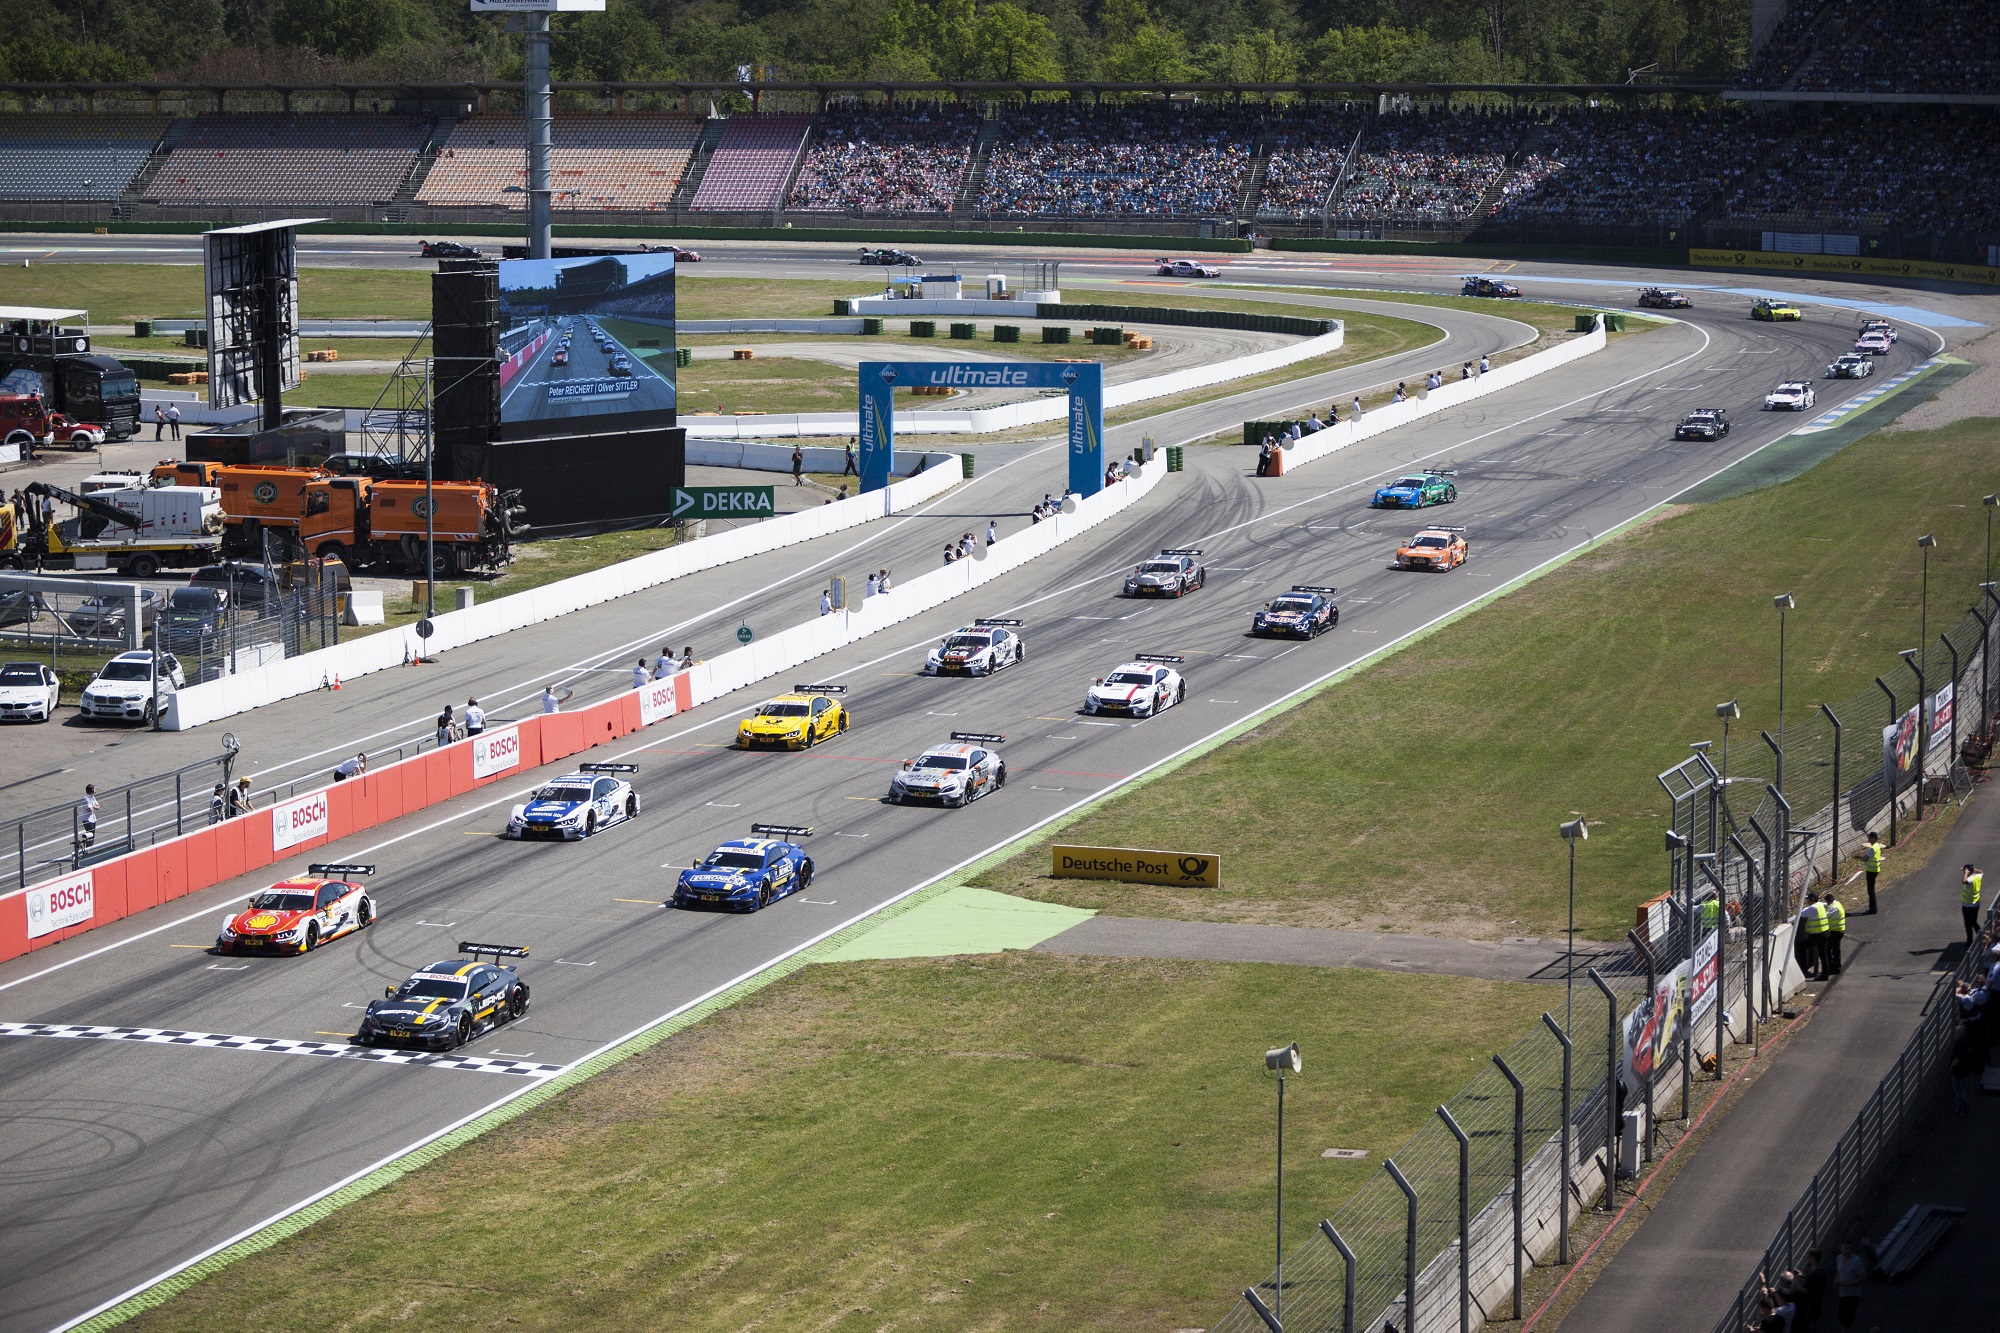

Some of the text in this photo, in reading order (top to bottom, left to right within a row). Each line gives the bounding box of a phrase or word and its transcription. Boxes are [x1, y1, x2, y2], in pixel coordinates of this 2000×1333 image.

[1694, 254, 1720, 262] Deutsche
[1755, 258, 1781, 266] Deutsche
[1812, 261, 1839, 269] Deutsche
[930, 366, 1028, 384] ultimate
[549, 387, 564, 396] Peter
[565, 384, 594, 394] REICHERT
[598, 382, 614, 392] Oliver
[615, 380, 638, 391] SITTLER
[862, 394, 874, 452] ultimate
[1070, 396, 1083, 454] ultimate
[704, 492, 771, 511] DEKRA
[653, 685, 674, 707] BOSCH
[490, 735, 517, 759] BOSCH
[293, 801, 325, 829] BOSCH
[1062, 856, 1169, 874] Deutsche Post
[50, 882, 91, 913] BOSCH
[260, 894, 277, 904] 18
[52, 918, 68, 927] Technik
[79, 909, 91, 918] Leben
[404, 980, 420, 989] 3
